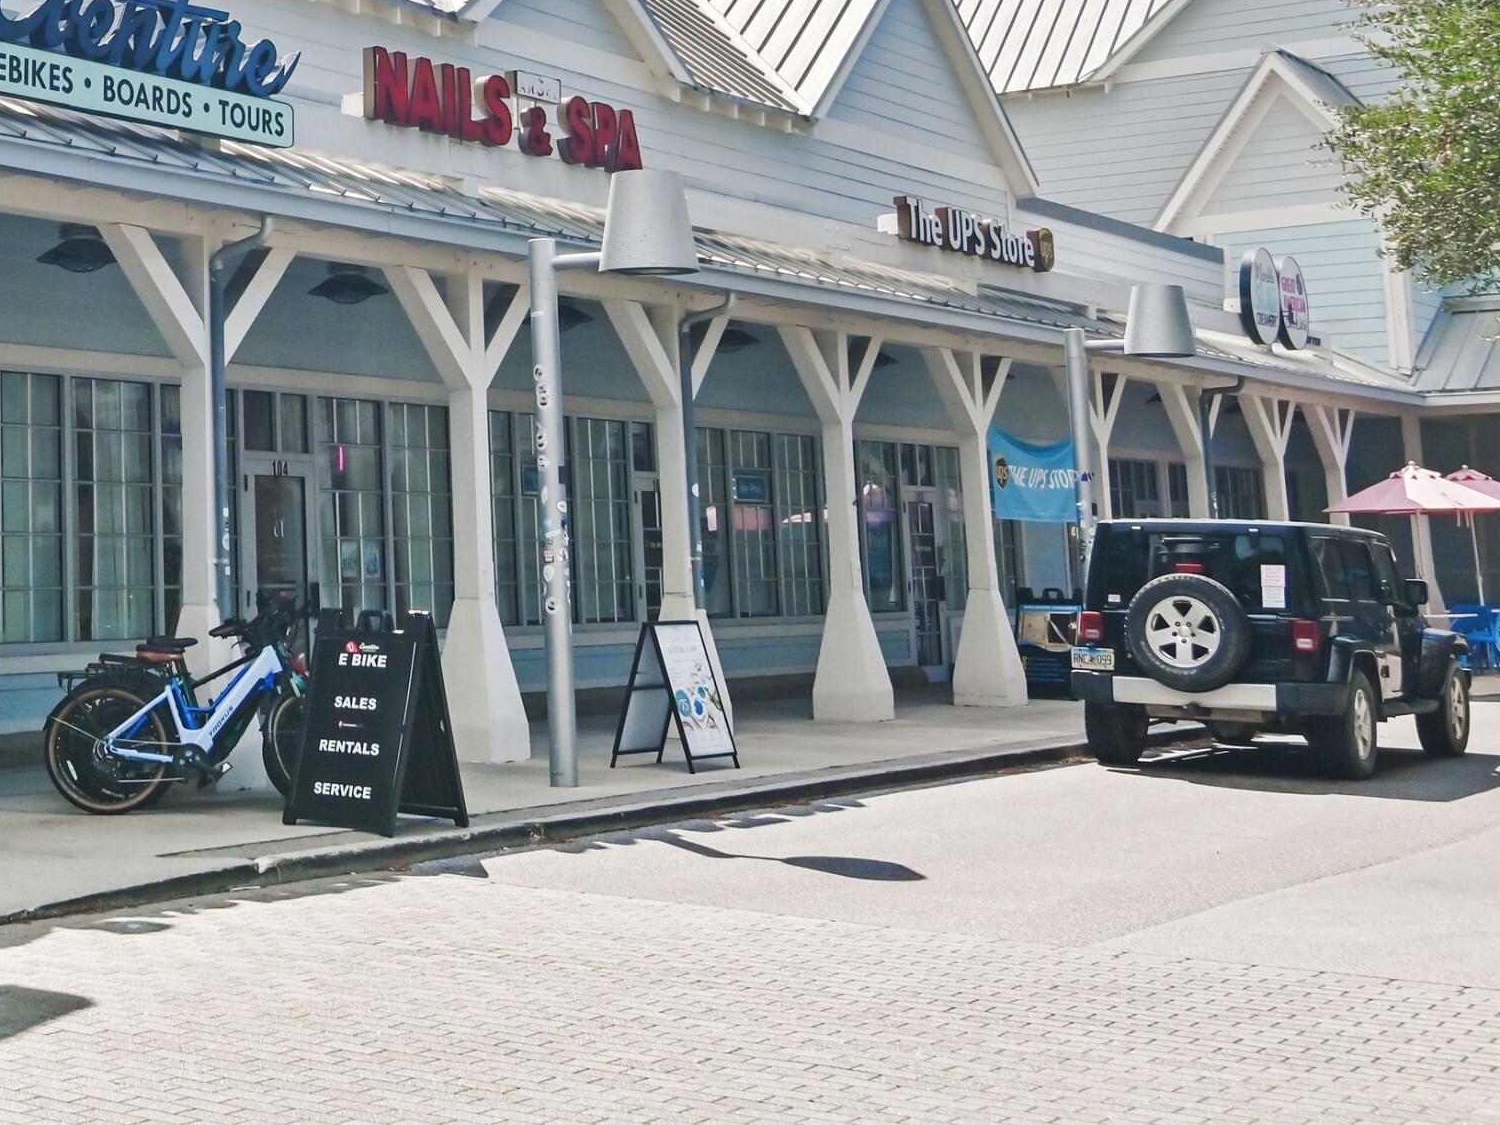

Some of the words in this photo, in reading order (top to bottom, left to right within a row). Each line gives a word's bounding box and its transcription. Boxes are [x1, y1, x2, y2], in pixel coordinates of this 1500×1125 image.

[103, 75, 193, 118] BOARDS
[218, 99, 284, 137] TOURS
[364, 45, 512, 147] NAILS
[518, 106, 553, 157] &
[557, 95, 643, 172] SPA
[900, 195, 943, 247] The
[944, 207, 985, 256] UPS
[989, 218, 1035, 267] Store
[272, 460, 288, 476] 104
[1008, 465, 1028, 487] THE
[1028, 468, 1047, 488] UPS
[1048, 469, 1077, 489] STOR
[338, 653, 348, 665] E
[351, 654, 387, 668] BIKE
[334, 695, 377, 710] SALES
[319, 739, 380, 756] RENTALS
[313, 781, 372, 800] SERVICE
